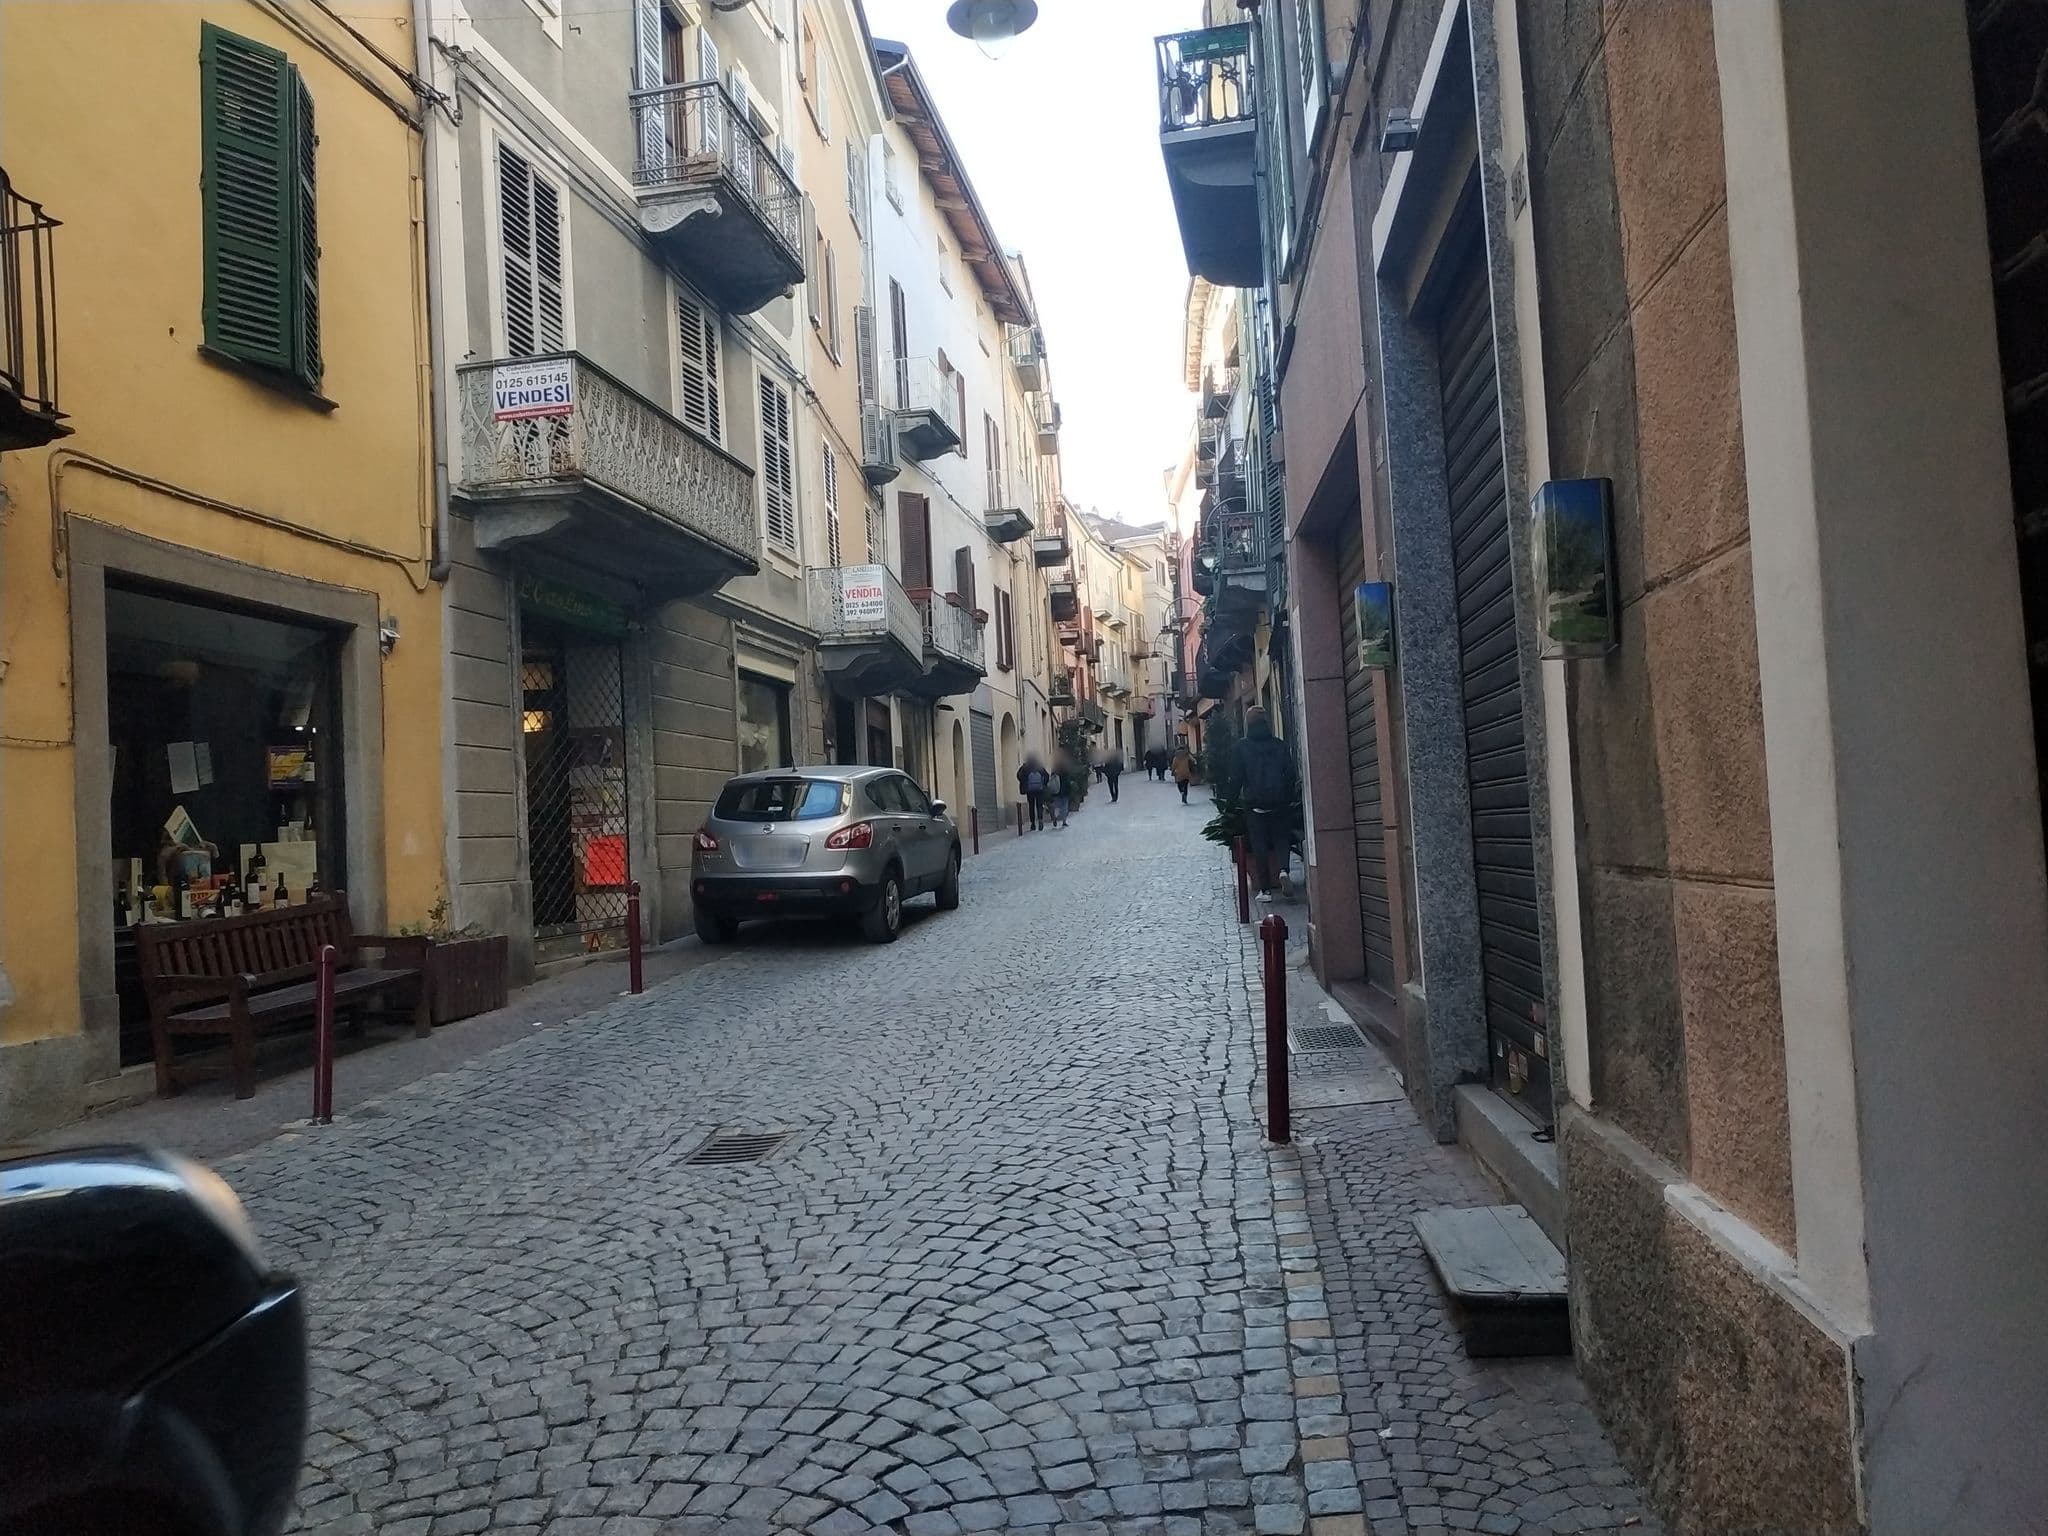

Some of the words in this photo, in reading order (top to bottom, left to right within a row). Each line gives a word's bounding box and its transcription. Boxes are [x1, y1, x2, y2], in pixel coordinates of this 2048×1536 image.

[495, 378, 523, 390] 0125
[526, 372, 568, 386] 615145
[496, 383, 570, 409] VENDESI
[845, 587, 882, 599] VENDITA
[845, 601, 860, 609] 0125
